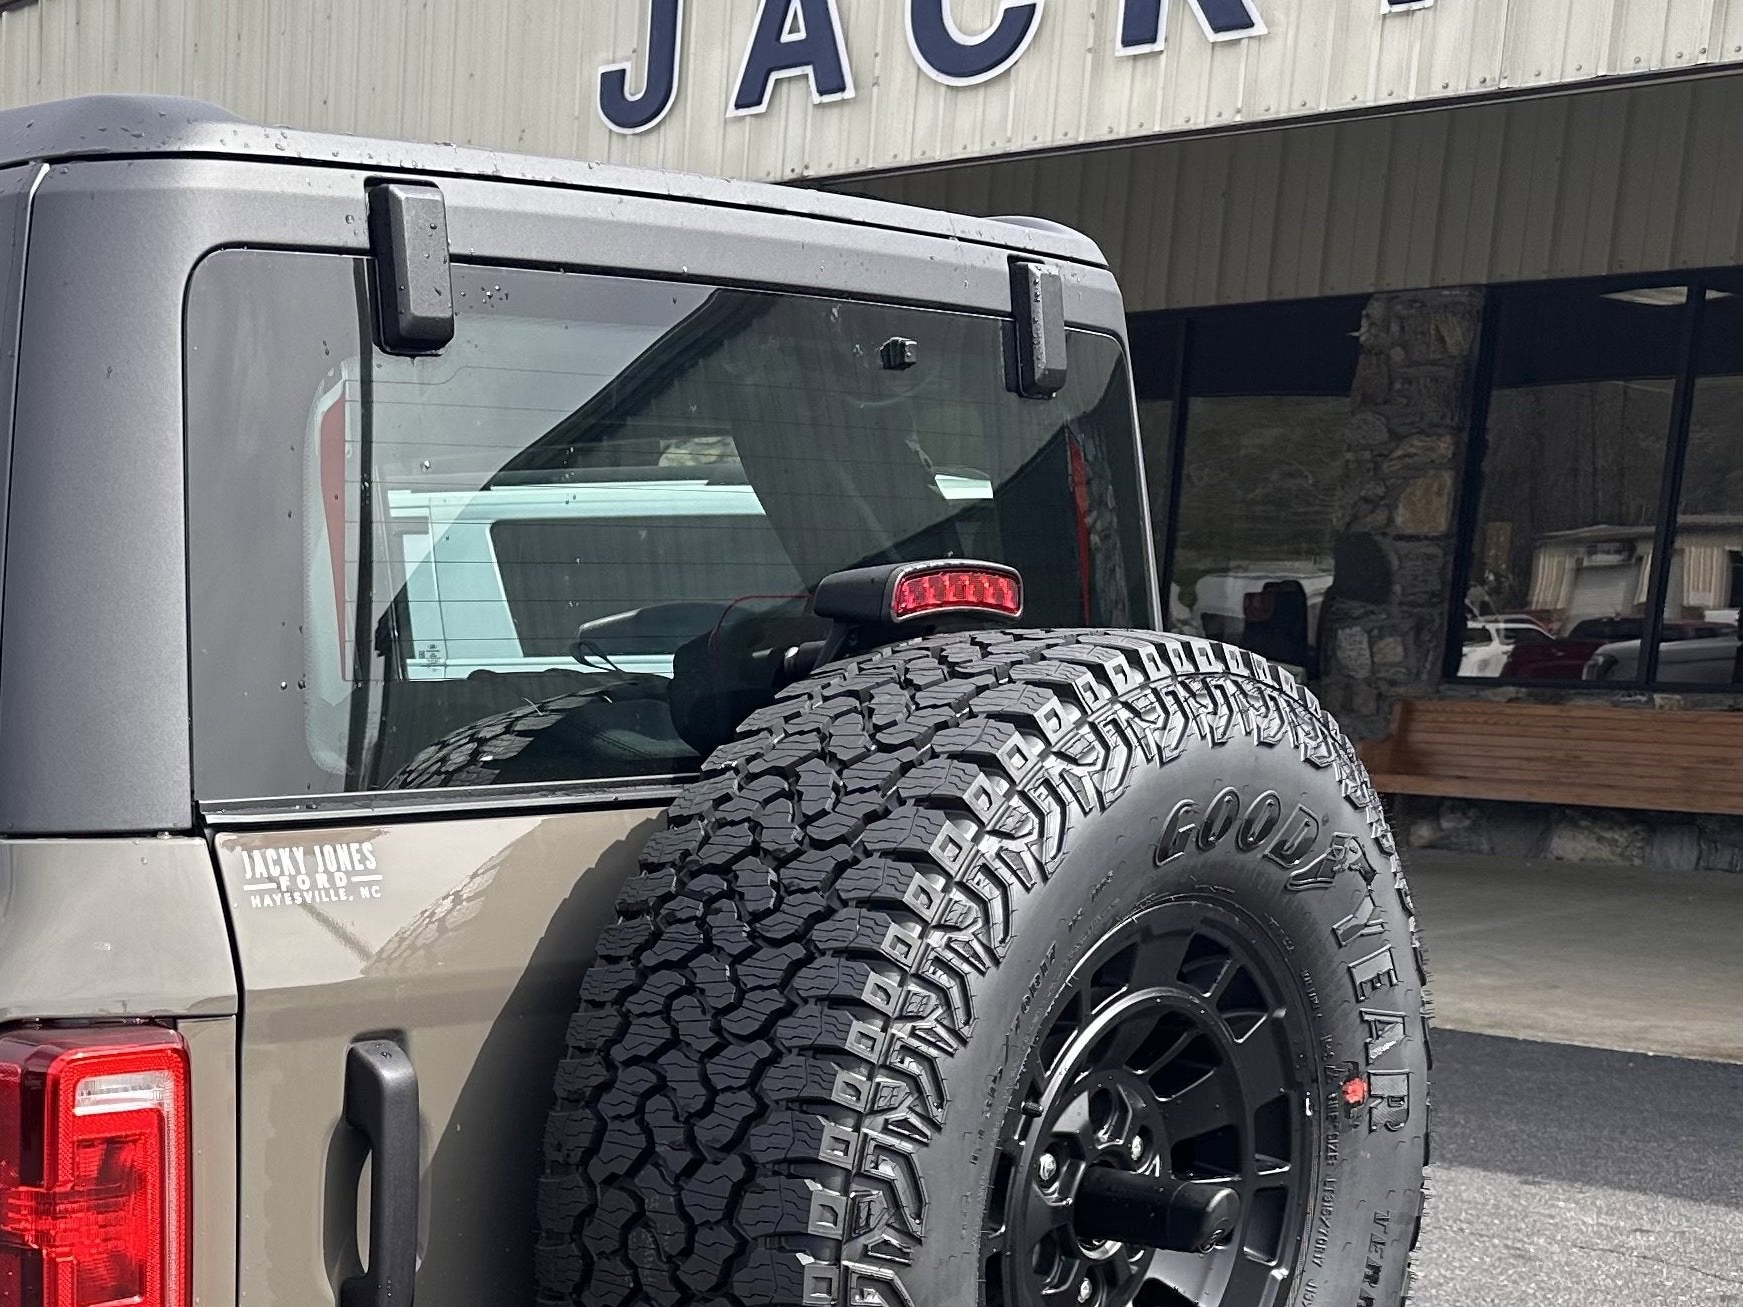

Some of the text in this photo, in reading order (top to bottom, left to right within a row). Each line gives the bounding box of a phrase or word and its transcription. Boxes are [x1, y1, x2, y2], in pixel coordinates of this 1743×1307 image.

[598, 0, 1435, 135] JAC
[241, 842, 377, 880] JACKY JONES
[250, 885, 382, 909] HAYESVILLE, NC
[278, 871, 348, 892] FORD
[1153, 786, 1411, 1134] GOODYEAR
